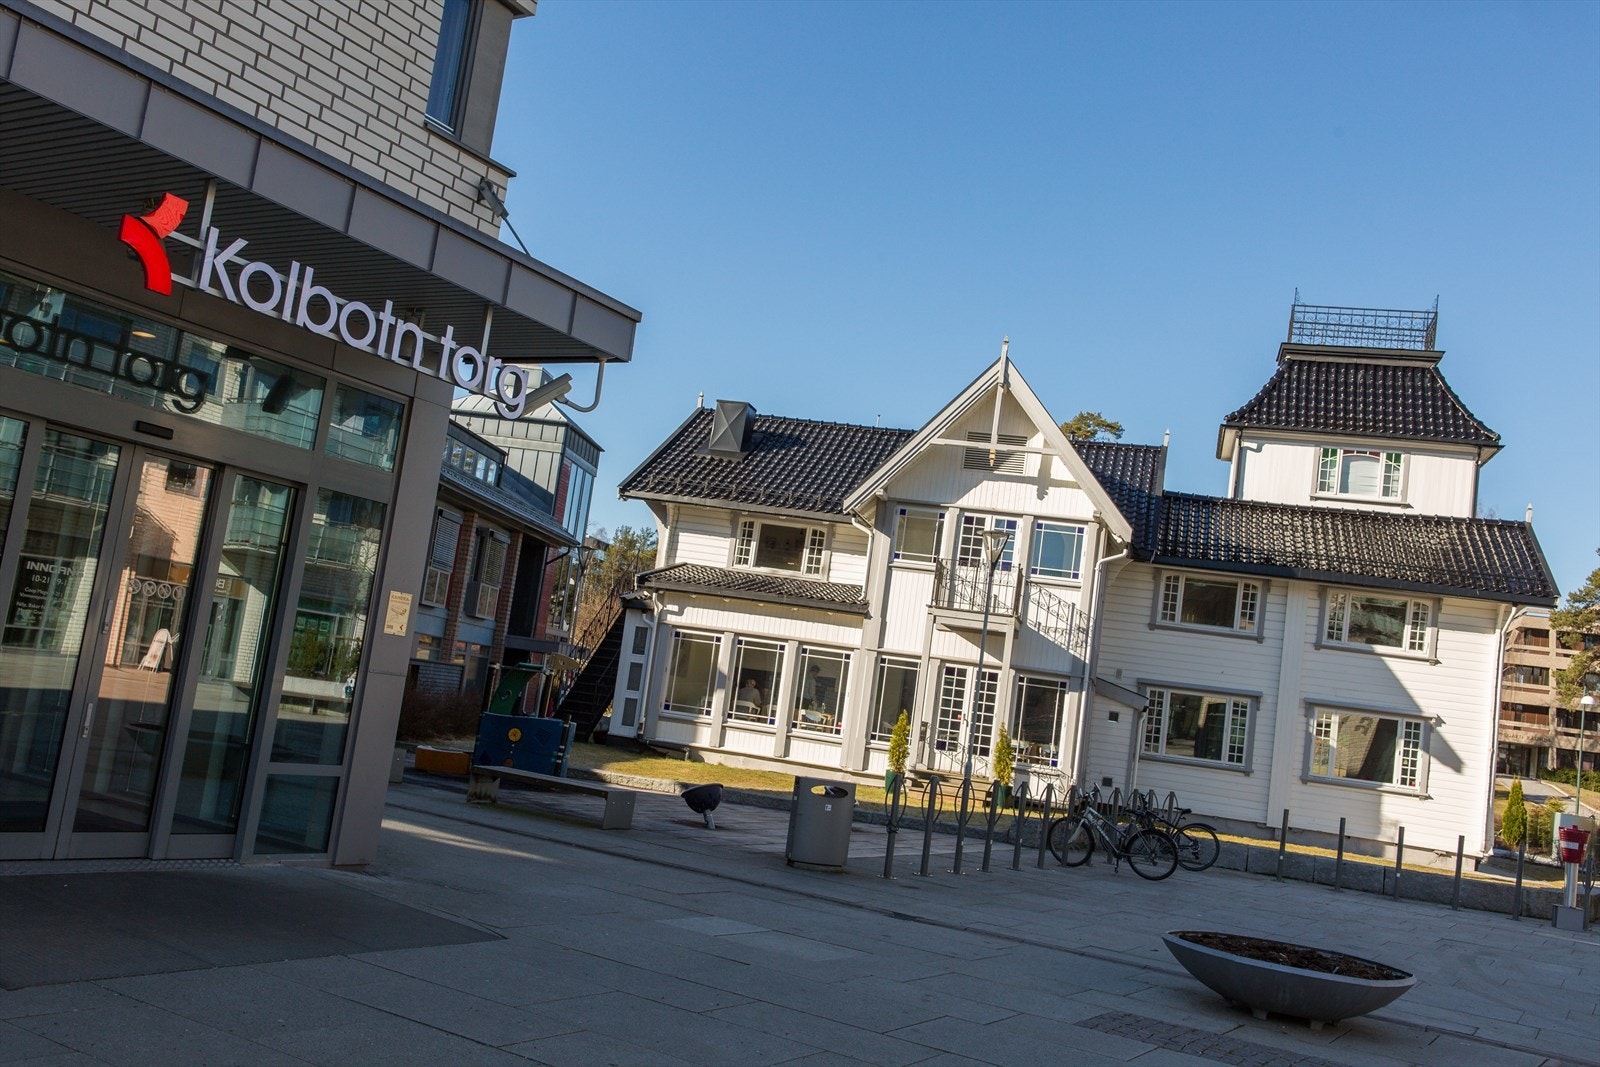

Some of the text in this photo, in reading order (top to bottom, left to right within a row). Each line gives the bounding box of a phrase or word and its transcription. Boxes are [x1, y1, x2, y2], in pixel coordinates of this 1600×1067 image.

[200, 226, 530, 419] Kolbotn torg
[26, 561, 83, 578] INNGAN
